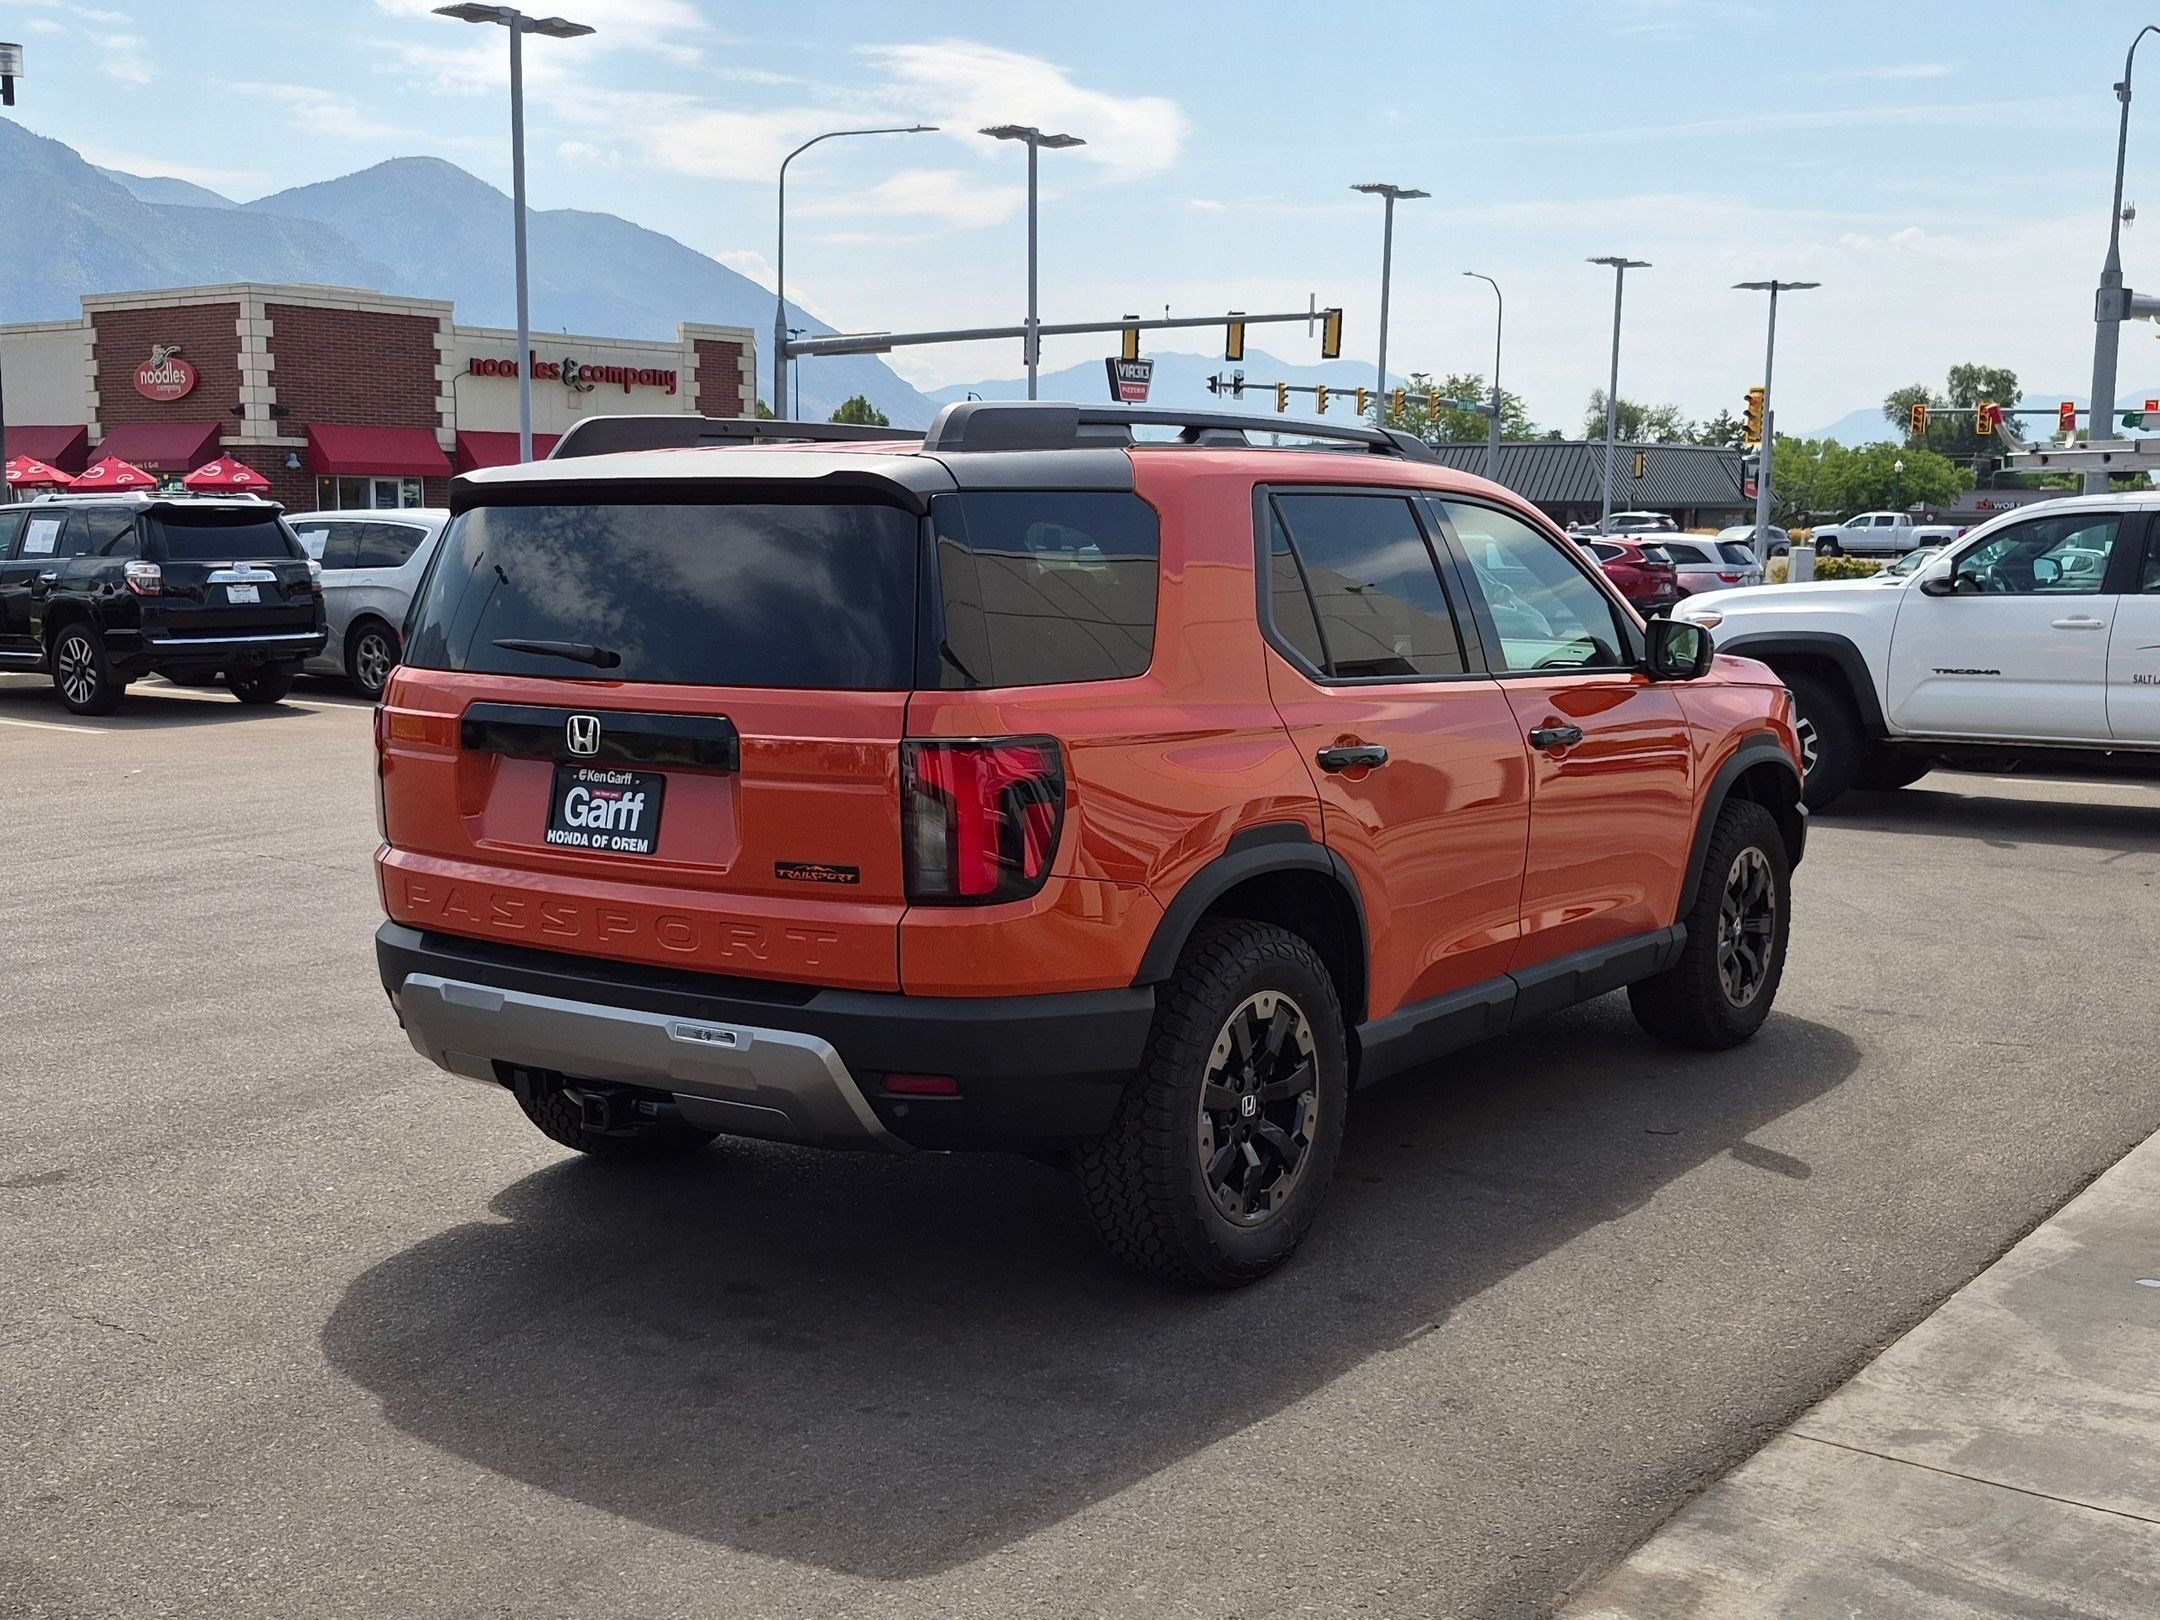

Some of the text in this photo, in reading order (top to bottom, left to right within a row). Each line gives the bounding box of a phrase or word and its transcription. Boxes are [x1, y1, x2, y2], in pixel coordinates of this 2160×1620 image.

[140, 361, 187, 385] noodles
[469, 350, 560, 380] nooles
[578, 363, 677, 395] company
[1931, 668, 2001, 676] TACOMA
[2133, 673, 2152, 685] SALT
[587, 769, 633, 785] Ken Garff
[564, 786, 645, 832] Garff
[547, 829, 649, 853] HONDA OF OREM
[776, 869, 856, 882] TRAILSPORT
[403, 877, 839, 965] PASSPORT
